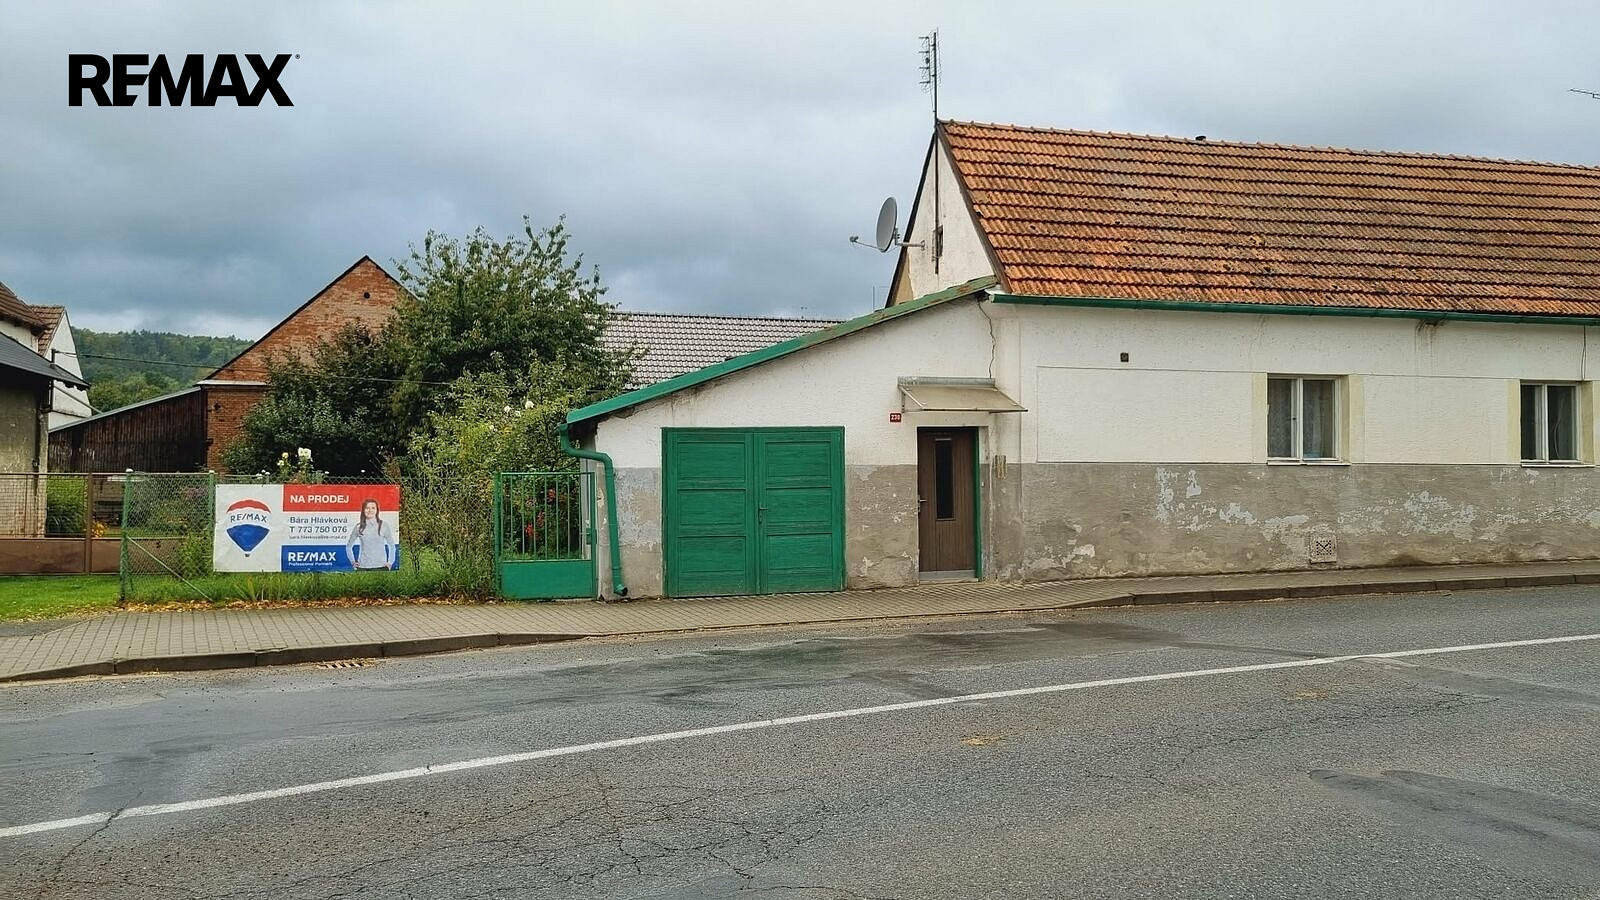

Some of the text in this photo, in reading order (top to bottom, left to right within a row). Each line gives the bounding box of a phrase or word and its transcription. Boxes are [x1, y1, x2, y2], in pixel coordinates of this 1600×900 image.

[290, 495, 349, 503] NA PRODEJ
[230, 513, 267, 523] RE/MAX
[288, 552, 336, 561] RE/MAX
